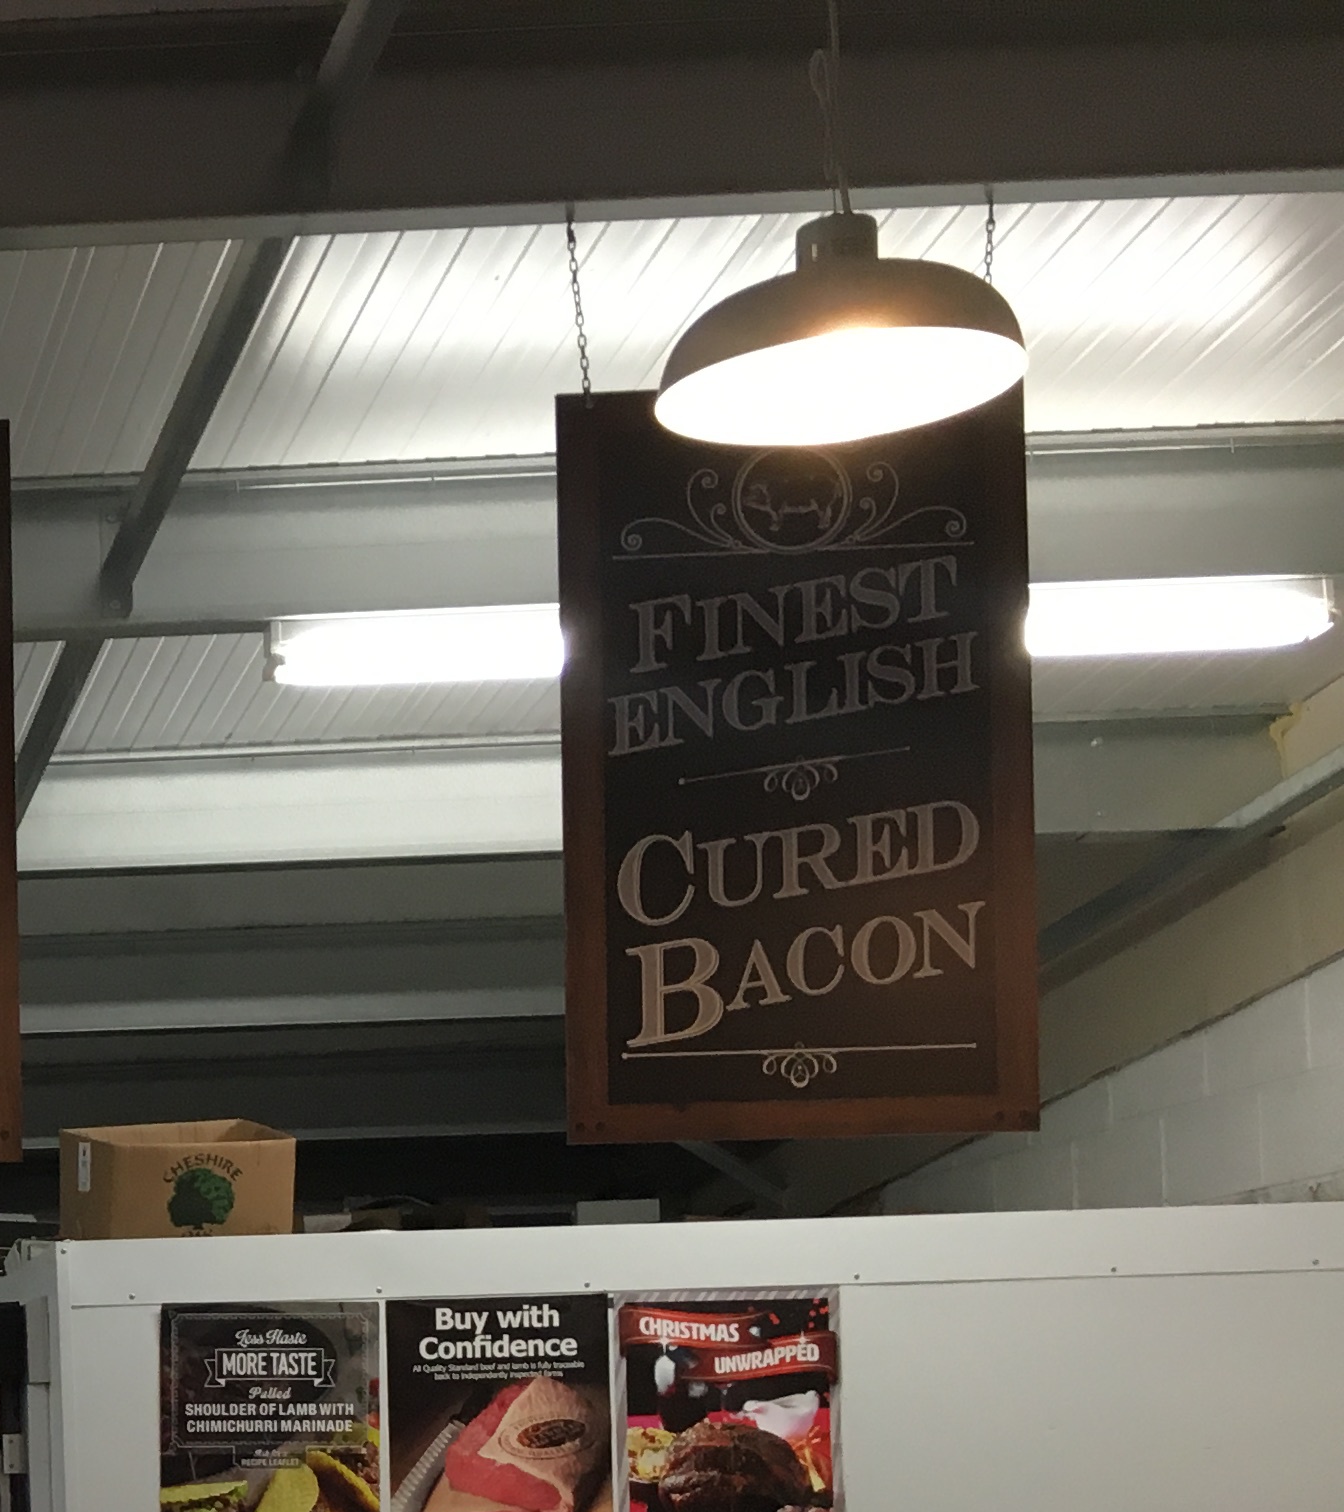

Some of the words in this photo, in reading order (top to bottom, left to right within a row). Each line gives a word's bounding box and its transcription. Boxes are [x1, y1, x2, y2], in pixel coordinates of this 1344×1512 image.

[628, 555, 957, 674] FINEST
[607, 630, 980, 757] ENGLISH
[617, 799, 980, 926] CURED
[624, 900, 987, 1049] BACON
[162, 1152, 244, 1183] CHESHIRE
[435, 1307, 489, 1335] Buy
[496, 1303, 560, 1329] with
[639, 1316, 740, 1343] CHRISTMAS
[235, 1329, 264, 1347] Less
[418, 1333, 579, 1361] Confidence
[222, 1352, 268, 1376] MORE
[270, 1352, 318, 1376] TASTE
[714, 1343, 820, 1375] UNWRAPPED
[248, 1387, 292, 1400] Pulled
[185, 1403, 257, 1416] SHOULDER
[259, 1403, 277, 1416] OF
[278, 1403, 317, 1416] LAMB
[319, 1403, 355, 1416] WITH
[186, 1420, 278, 1433] CHIMICHURRI
[280, 1419, 354, 1432] MARINADE
